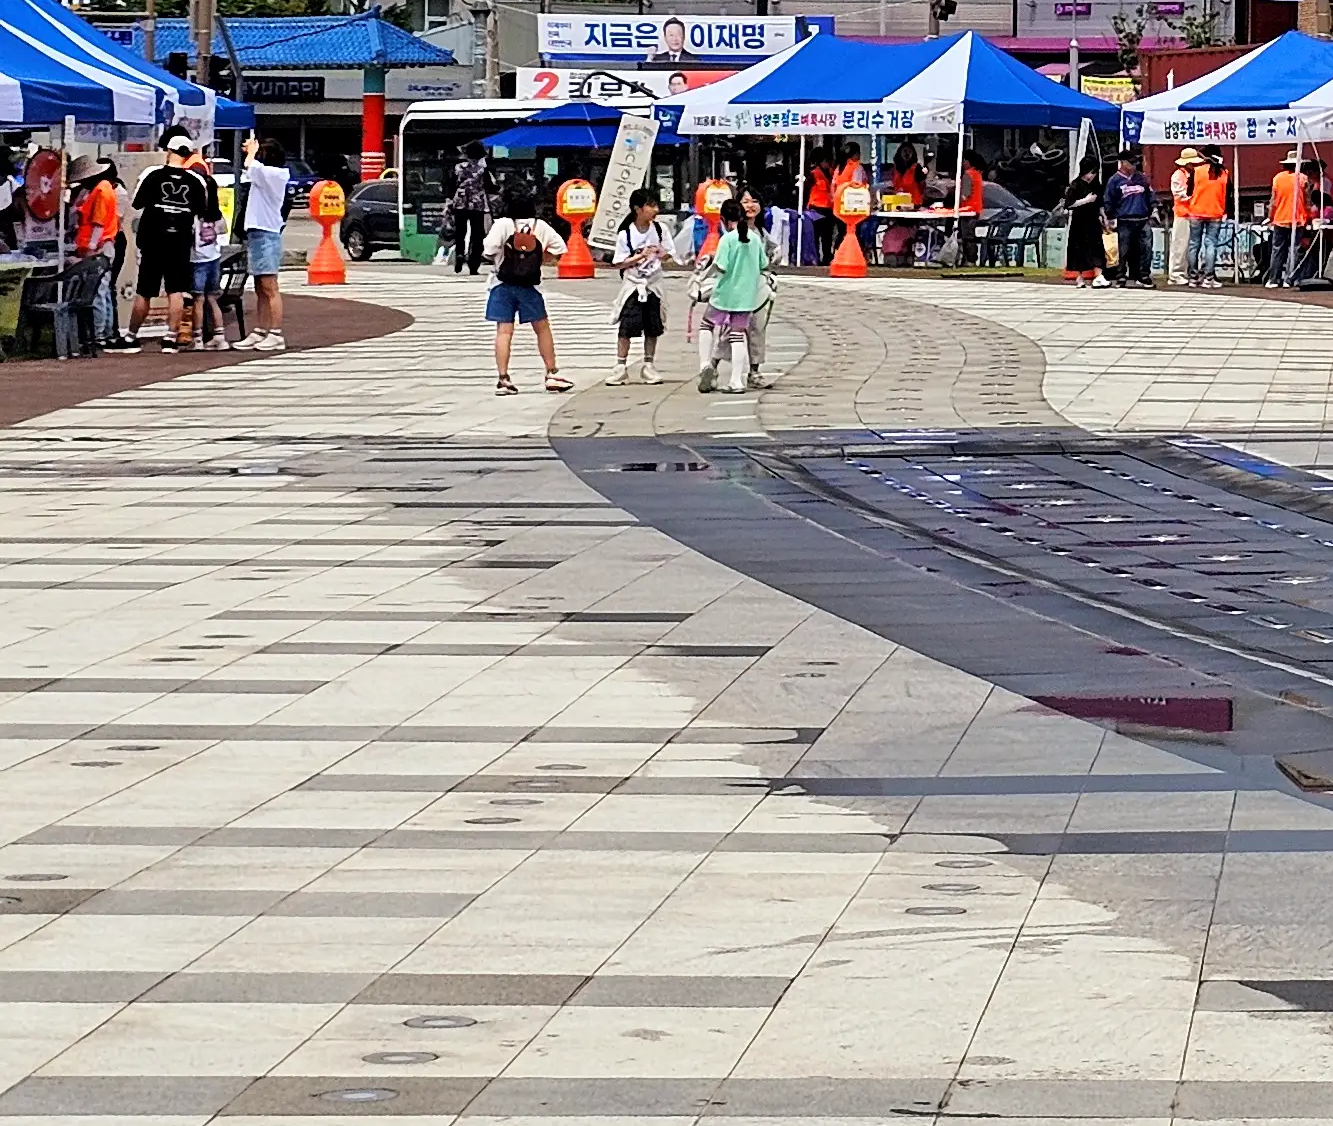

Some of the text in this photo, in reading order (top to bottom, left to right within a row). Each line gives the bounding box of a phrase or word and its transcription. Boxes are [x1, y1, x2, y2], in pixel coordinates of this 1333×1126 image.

[584, 22, 765, 50] 지금은 이재명
[533, 72, 560, 100] 2
[842, 109, 915, 129] 분리수거장
